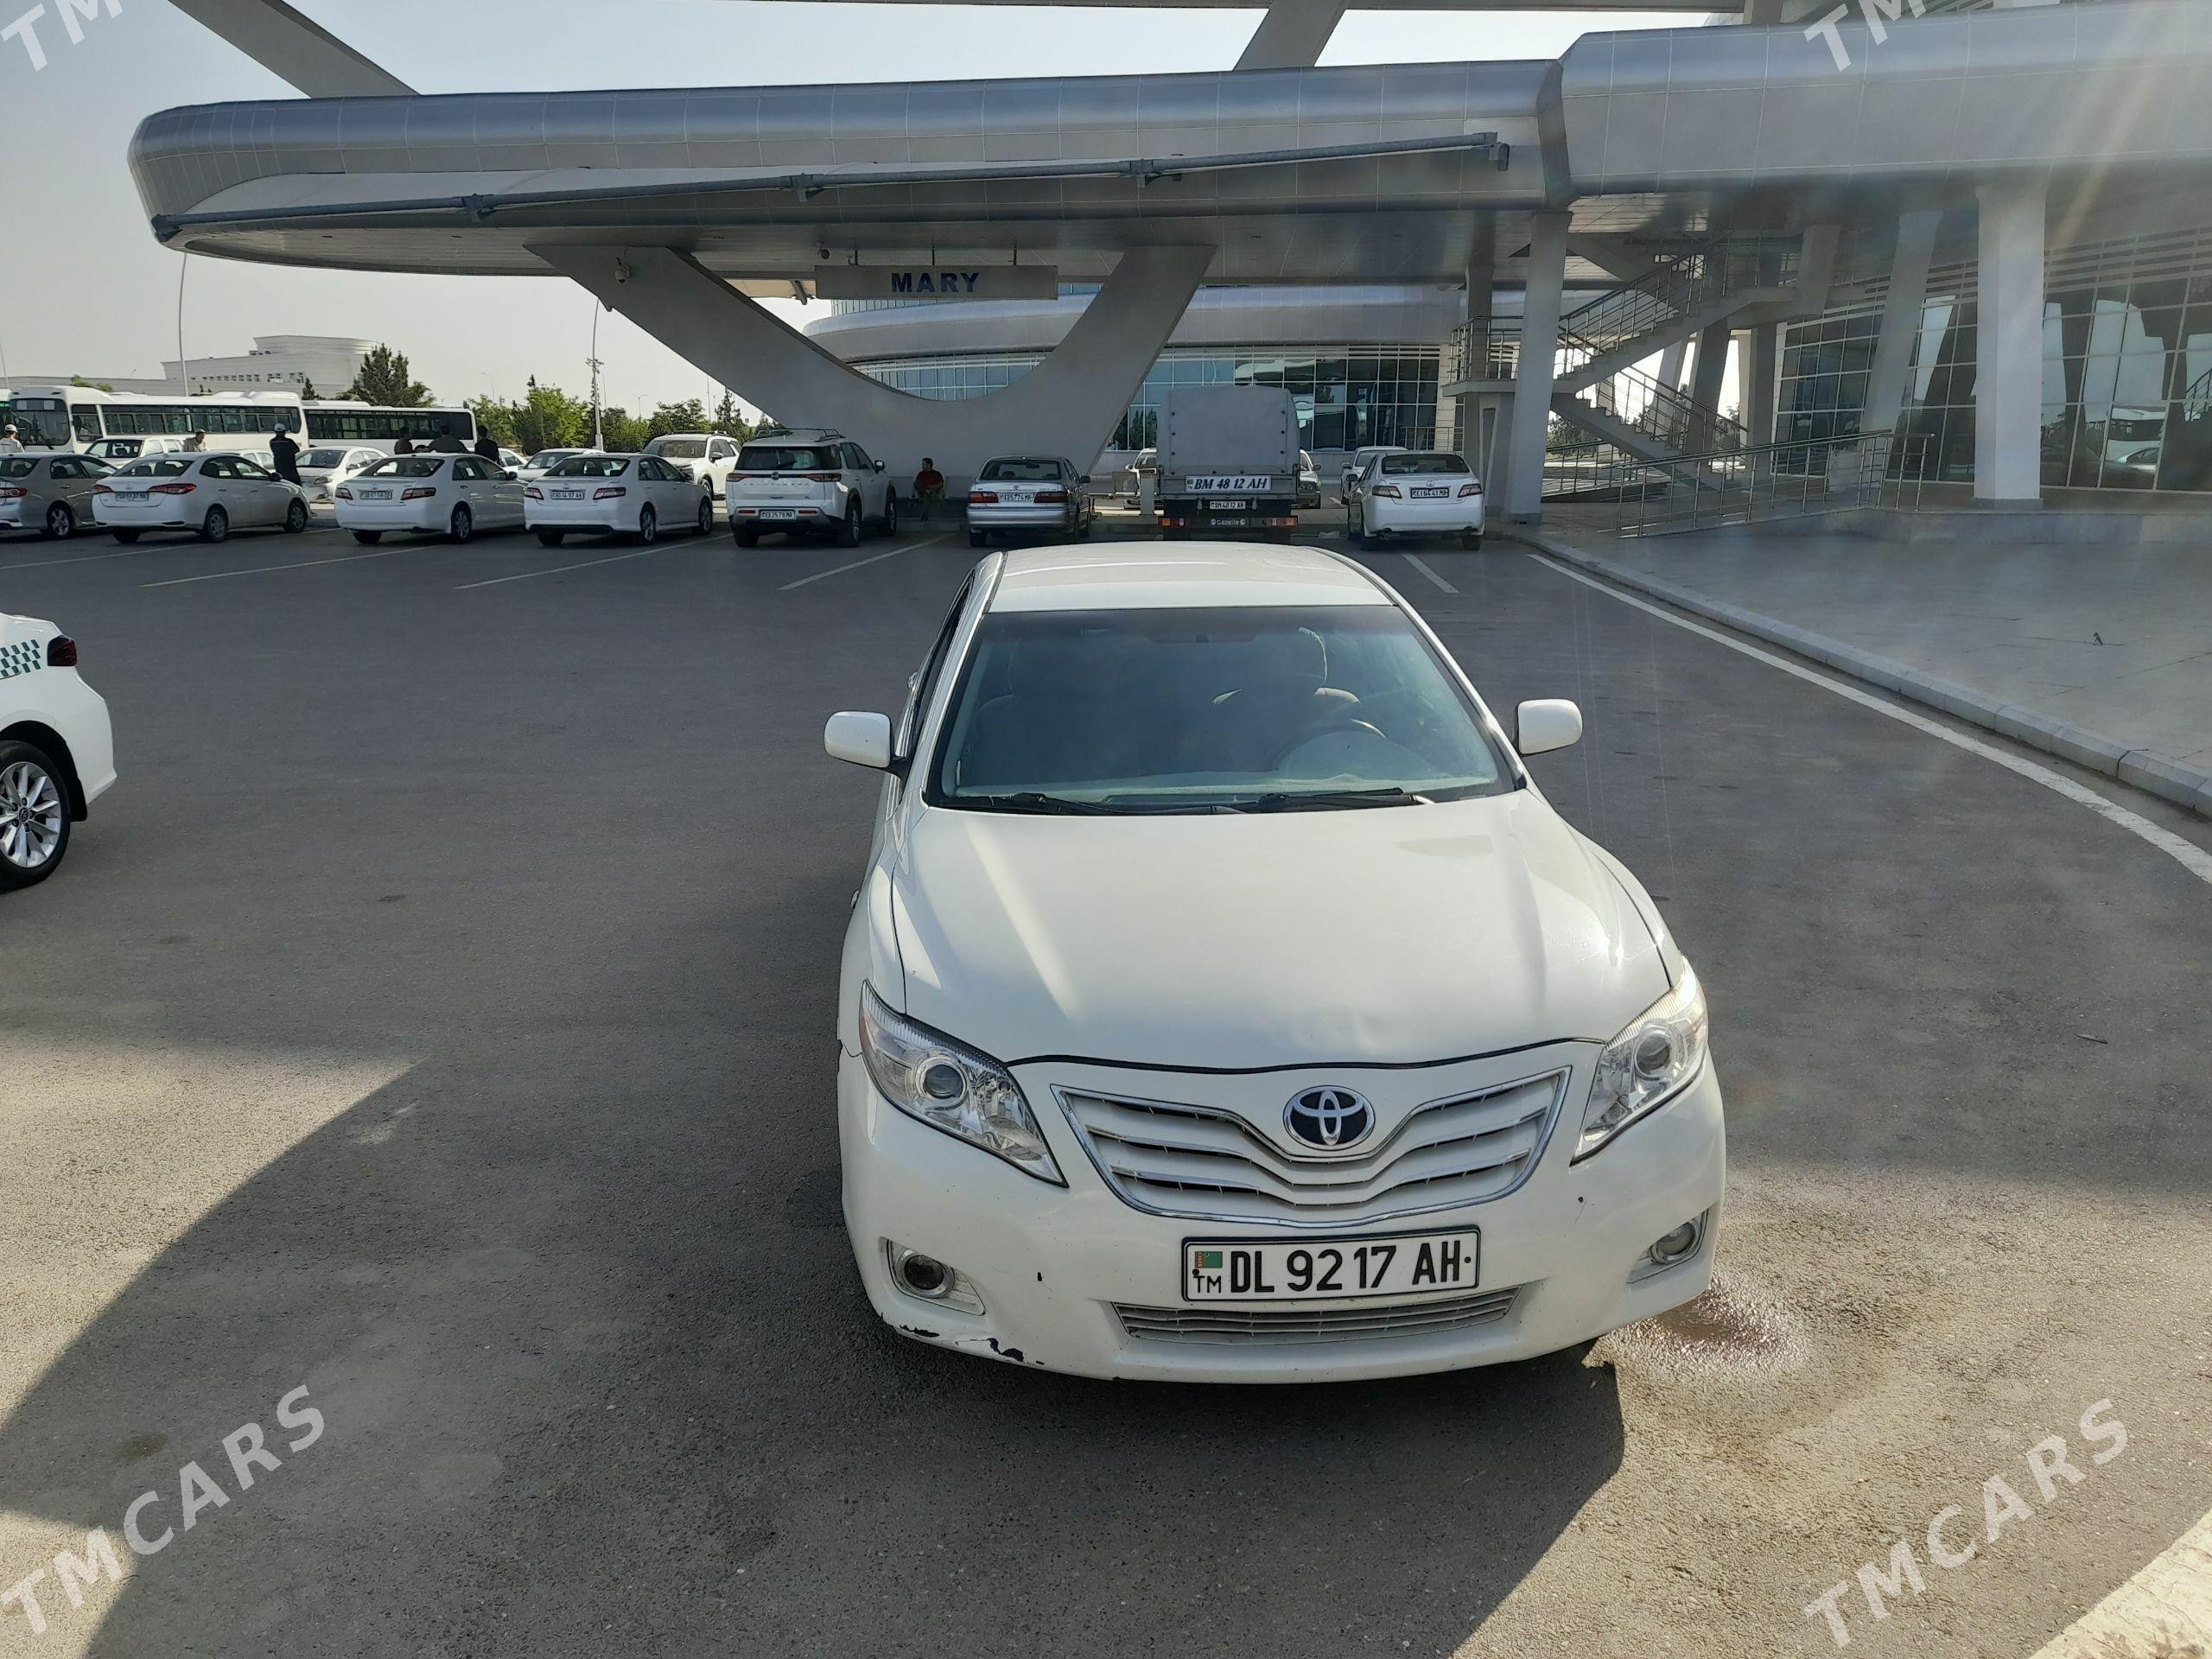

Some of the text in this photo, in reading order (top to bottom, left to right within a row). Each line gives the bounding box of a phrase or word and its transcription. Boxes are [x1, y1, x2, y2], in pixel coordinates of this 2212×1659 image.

[891, 272, 980, 293] MARY
[1194, 478, 1214, 490] BM
[1217, 478, 1230, 489] 48
[1234, 478, 1245, 489] 12
[1247, 478, 1268, 489] AH
[1193, 1240, 1460, 1294] TM DL 92 17 AH
